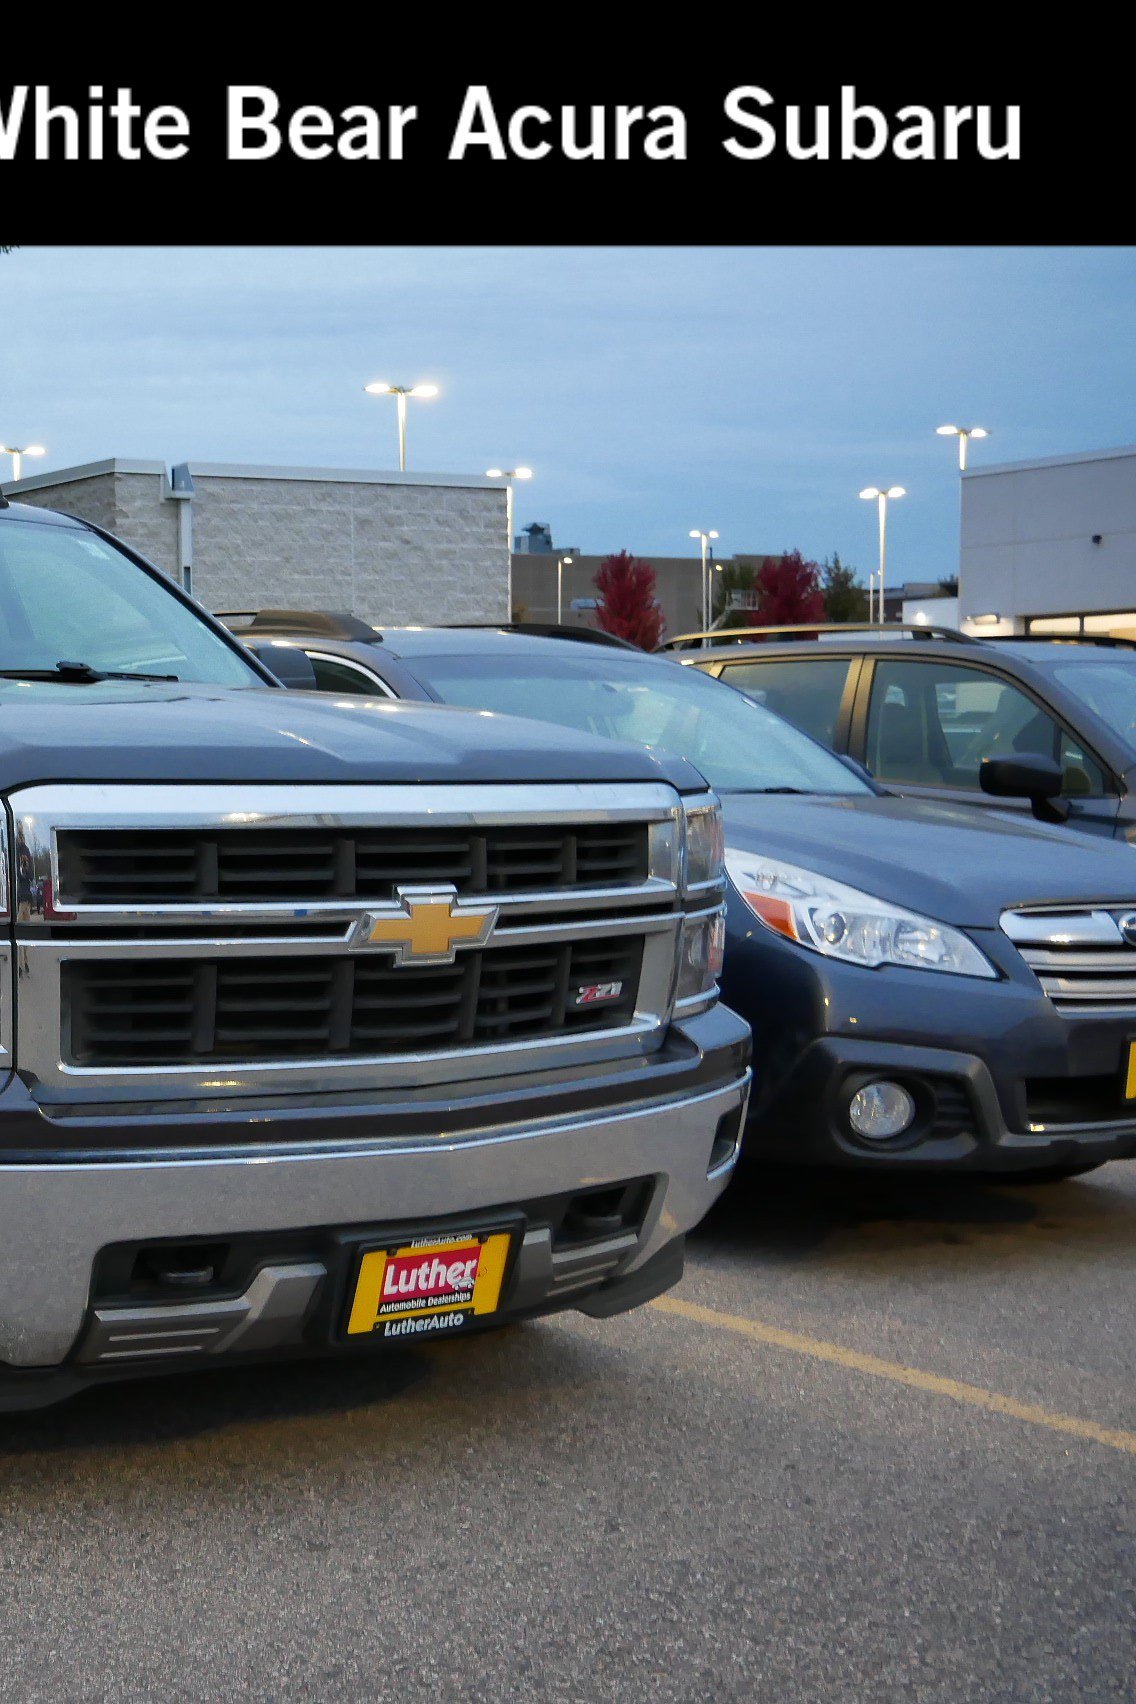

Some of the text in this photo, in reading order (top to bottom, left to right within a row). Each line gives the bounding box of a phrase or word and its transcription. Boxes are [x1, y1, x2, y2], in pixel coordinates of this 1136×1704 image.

[575, 981, 623, 1004] Z71
[383, 1258, 478, 1296] Luther
[379, 1292, 471, 1314] Automobile Dealerships
[384, 1312, 464, 1337] LutherAuto
